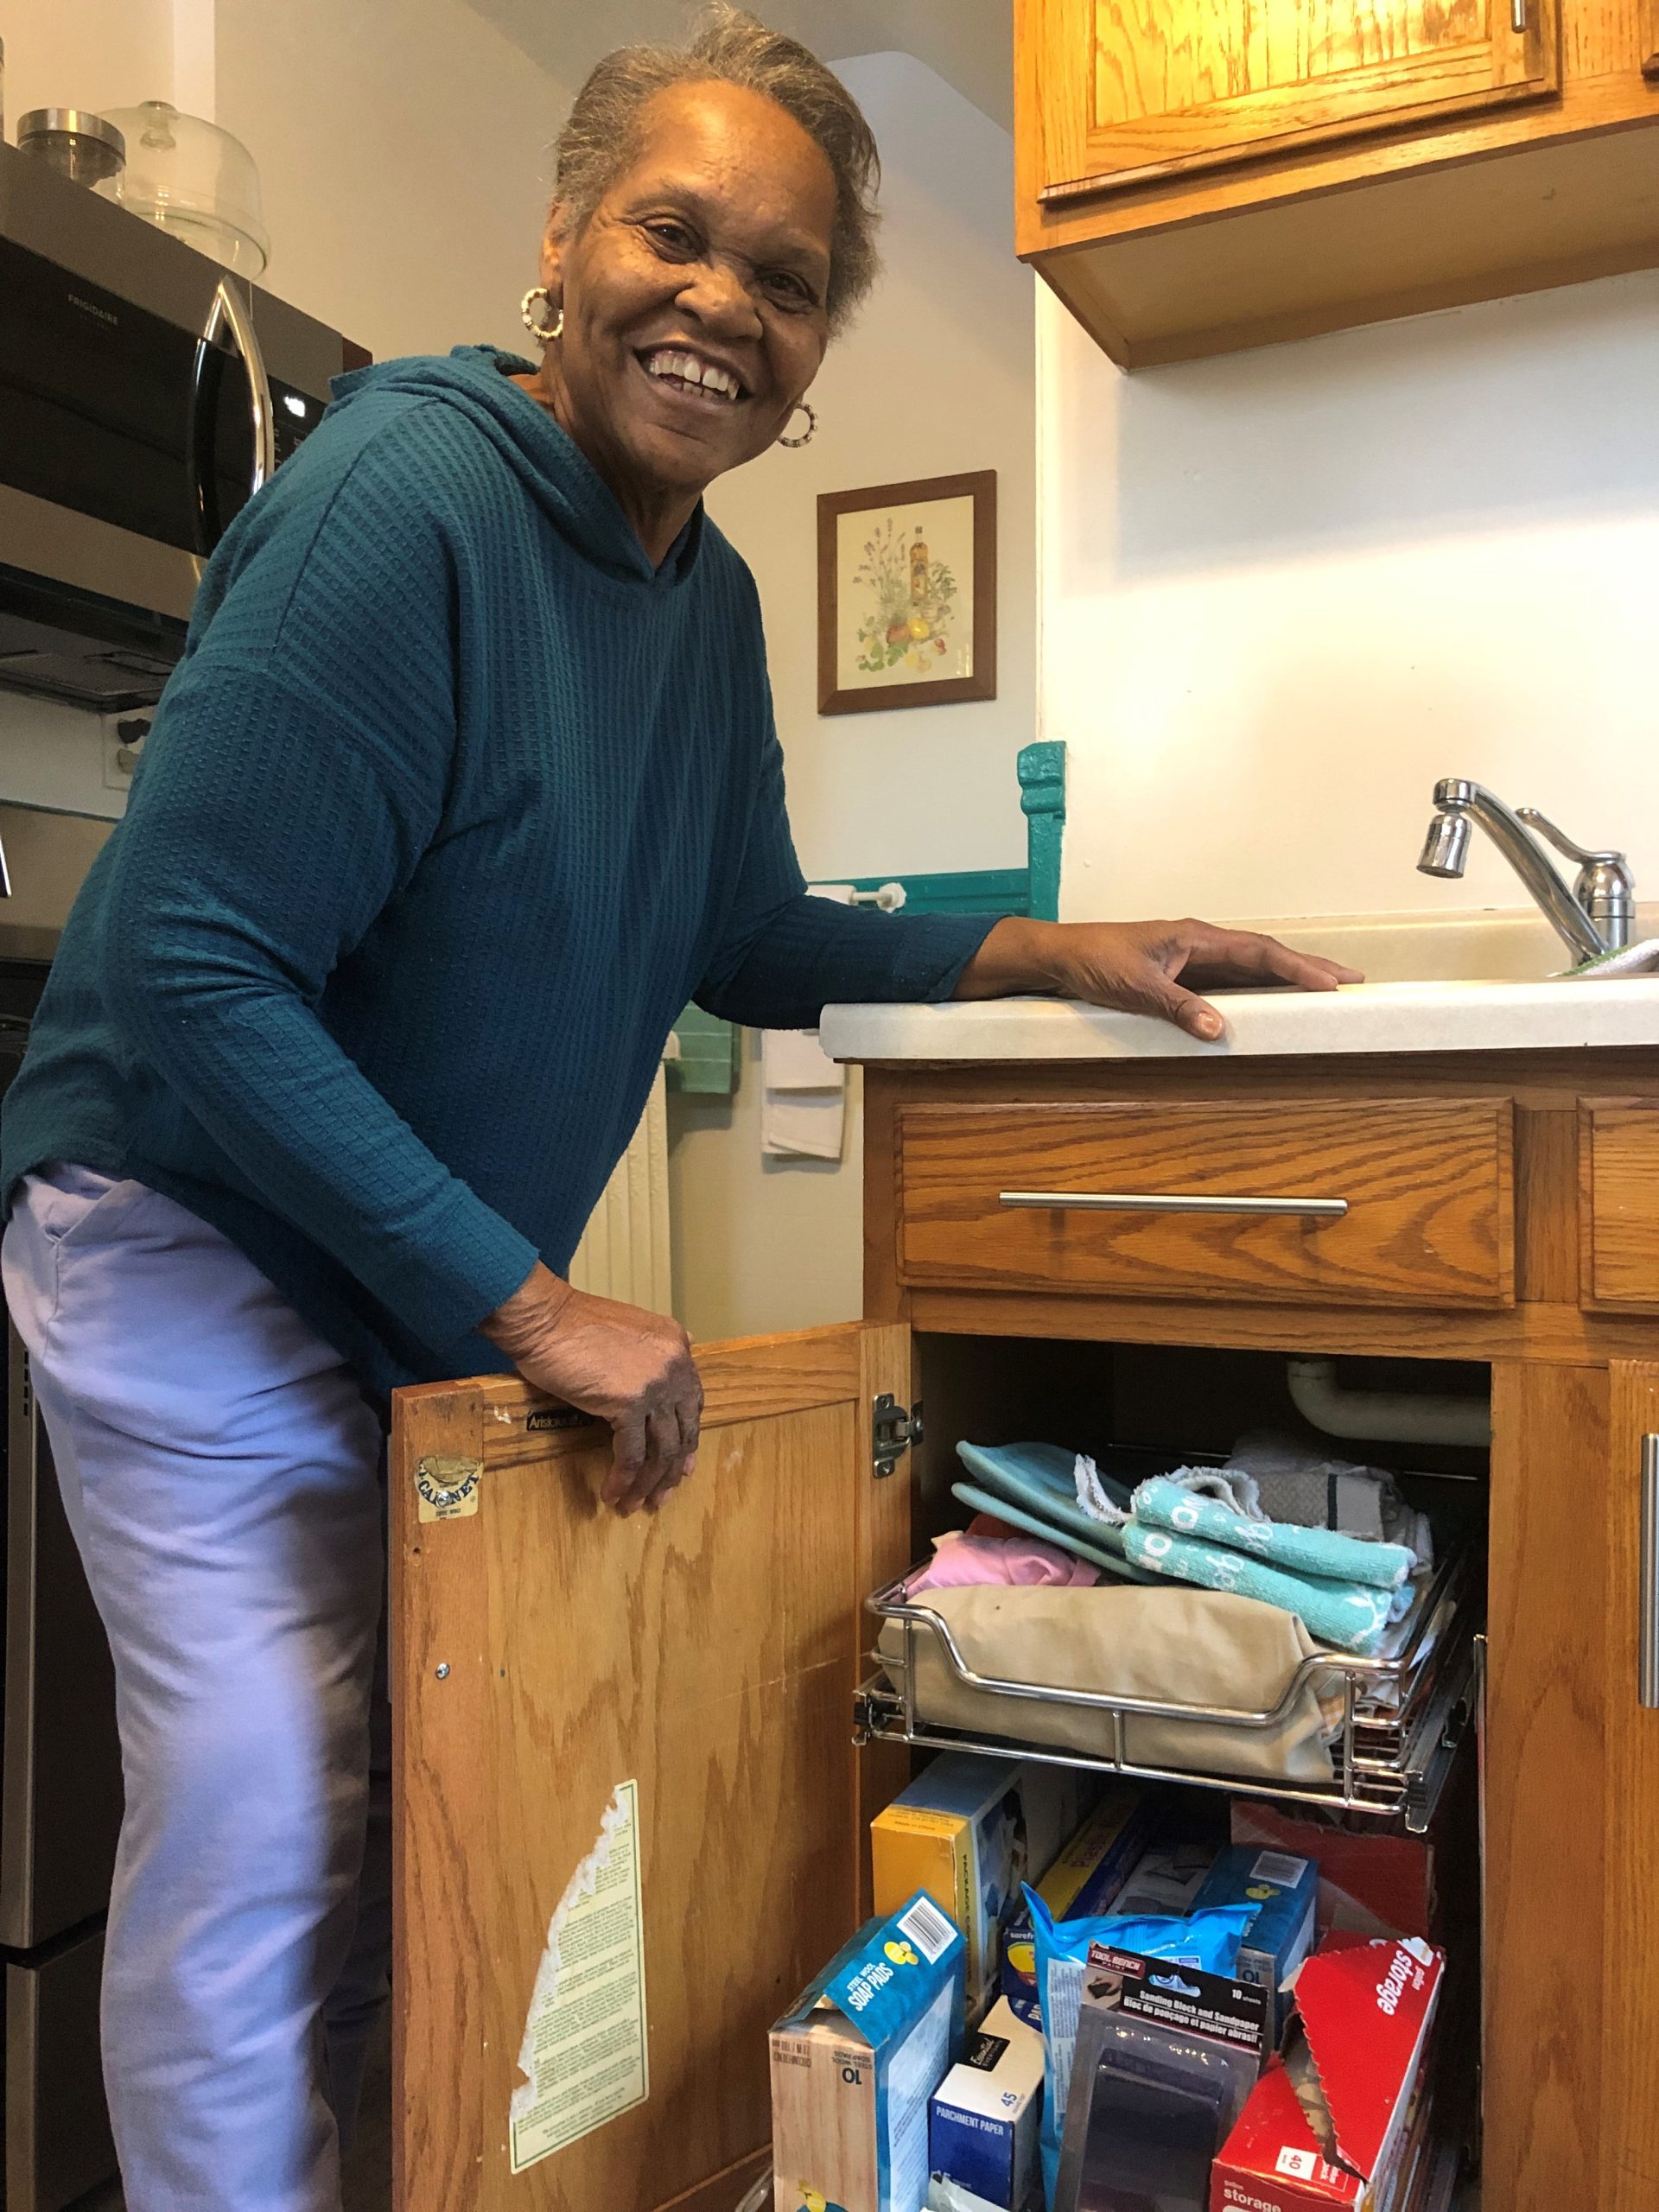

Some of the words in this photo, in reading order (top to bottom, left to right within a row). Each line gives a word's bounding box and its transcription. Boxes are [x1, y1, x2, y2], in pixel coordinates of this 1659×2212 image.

[68, 294, 118, 326] FRIGIDAIRE
[419, 1475, 479, 1508] CANET
[1090, 1949, 1111, 1964] TOOL
[1112, 1955, 1141, 1971] BENCH
[847, 1975, 864, 1992] STEEL
[860, 1962, 876, 1977] WOOL
[848, 1981, 874, 2012] SOAP
[867, 1961, 894, 1991] PADS
[1376, 1949, 1414, 2016] storage
[1232, 1988, 1243, 2001] 10
[1124, 1995, 1142, 2011] Bloc
[1142, 2003, 1154, 2014] de
[1154, 2006, 1189, 2025] ponçage
[1190, 2016, 1199, 2027] et
[1199, 2019, 1227, 2037] papier
[1228, 2025, 1258, 2044] abrasif
[1140, 1990, 1173, 2009] Sanding
[1173, 1999, 1197, 2014] Block
[1198, 2005, 1214, 2019] and
[1214, 2011, 1260, 2031] Sandpaper
[842, 2067, 862, 2085] 10
[1001, 2092, 1018, 2107] 45
[936, 2106, 979, 2128] PARCHMENT
[980, 2119, 1004, 2136] PAPER
[1288, 2154, 1302, 2170] 40
[1224, 2188, 1281, 2212] storage
